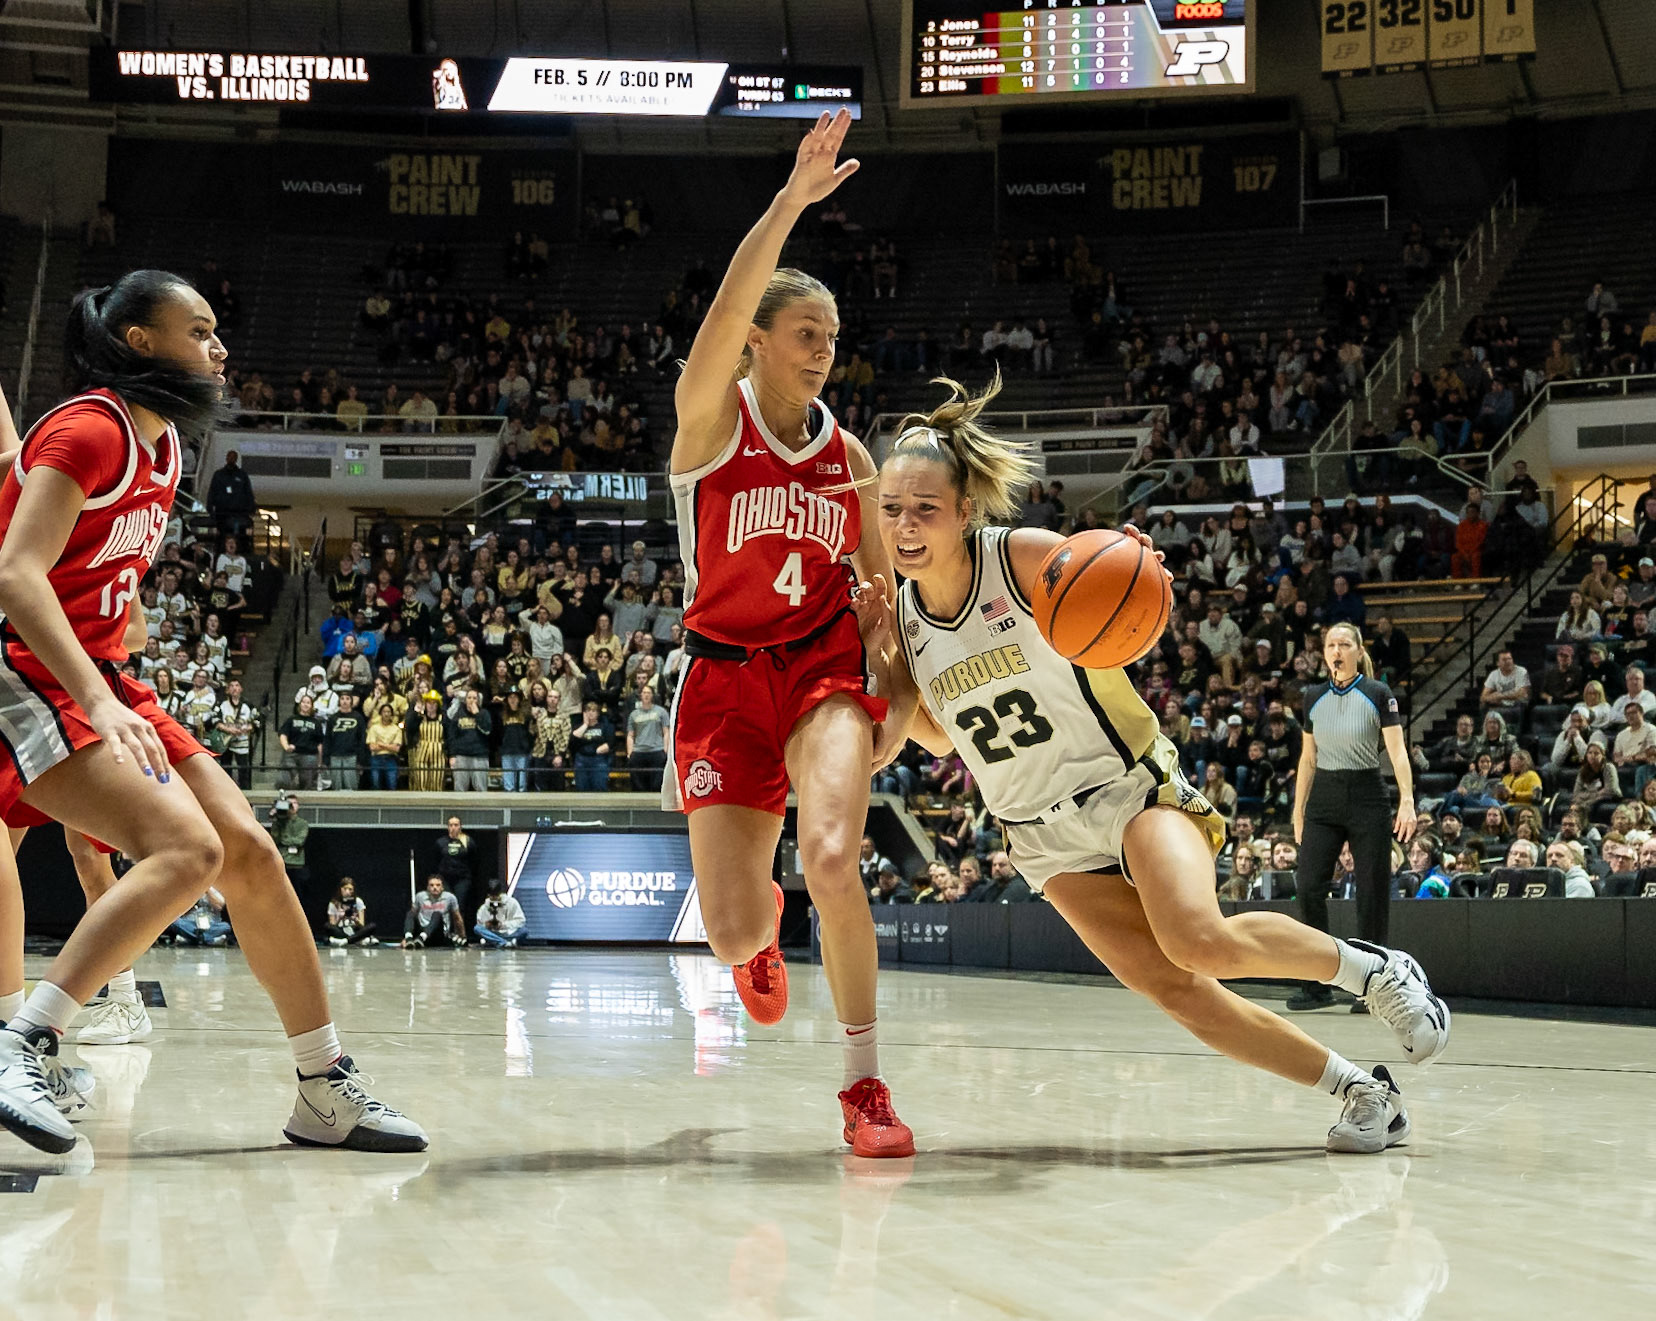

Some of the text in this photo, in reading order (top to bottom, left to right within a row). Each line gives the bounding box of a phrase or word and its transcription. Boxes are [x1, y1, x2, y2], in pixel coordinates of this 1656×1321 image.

[928, 11, 1129, 32] 2 Jones 11 2 2 0 1
[1175, 4, 1223, 20] FOODS
[1326, 1, 1366, 34] 22
[1380, 0, 1421, 28] 32
[922, 36, 935, 47] 10
[939, 34, 976, 47] Terry
[1072, 29, 1080, 40] 4
[1097, 27, 1105, 38] 0
[1123, 26, 1129, 37] 1
[922, 51, 935, 62] 15
[939, 48, 998, 62] Reynolds
[1049, 45, 1055, 56] 1
[1071, 43, 1080, 55] 0
[1096, 42, 1105, 54] 2
[1122, 41, 1129, 52] 1
[1165, 40, 1230, 77] P
[117, 52, 369, 81] WOMEN'S BASKETBALL
[534, 68, 570, 86] FEB.
[577, 70, 587, 86] 5
[620, 71, 660, 88] 8:00
[665, 72, 694, 89] PM
[921, 56, 1129, 78] 20 Stevenson 12 7 1 0 4
[177, 77, 311, 101] VS. ILLINOIS
[920, 81, 934, 93] 23
[938, 80, 967, 92] Ellis
[1021, 76, 1034, 88] 11
[1073, 74, 1079, 86] 1
[1096, 72, 1105, 84] 0
[1120, 71, 1129, 83] 2
[389, 154, 481, 185] PAINT
[1112, 145, 1204, 179] PAINT
[281, 179, 363, 196] WABASH
[1006, 182, 1086, 197] WABASH
[1234, 164, 1278, 193] 107
[389, 185, 481, 216] CREW
[512, 179, 555, 205] 106
[1112, 176, 1203, 210] CREW
[773, 552, 806, 606] 4
[99, 567, 140, 619] 12
[929, 643, 1031, 712] PURDUE
[333, 718, 358, 732] P
[955, 688, 1054, 765] 23
[589, 872, 676, 891] PURDUE
[588, 891, 665, 906] GLOBAL.
